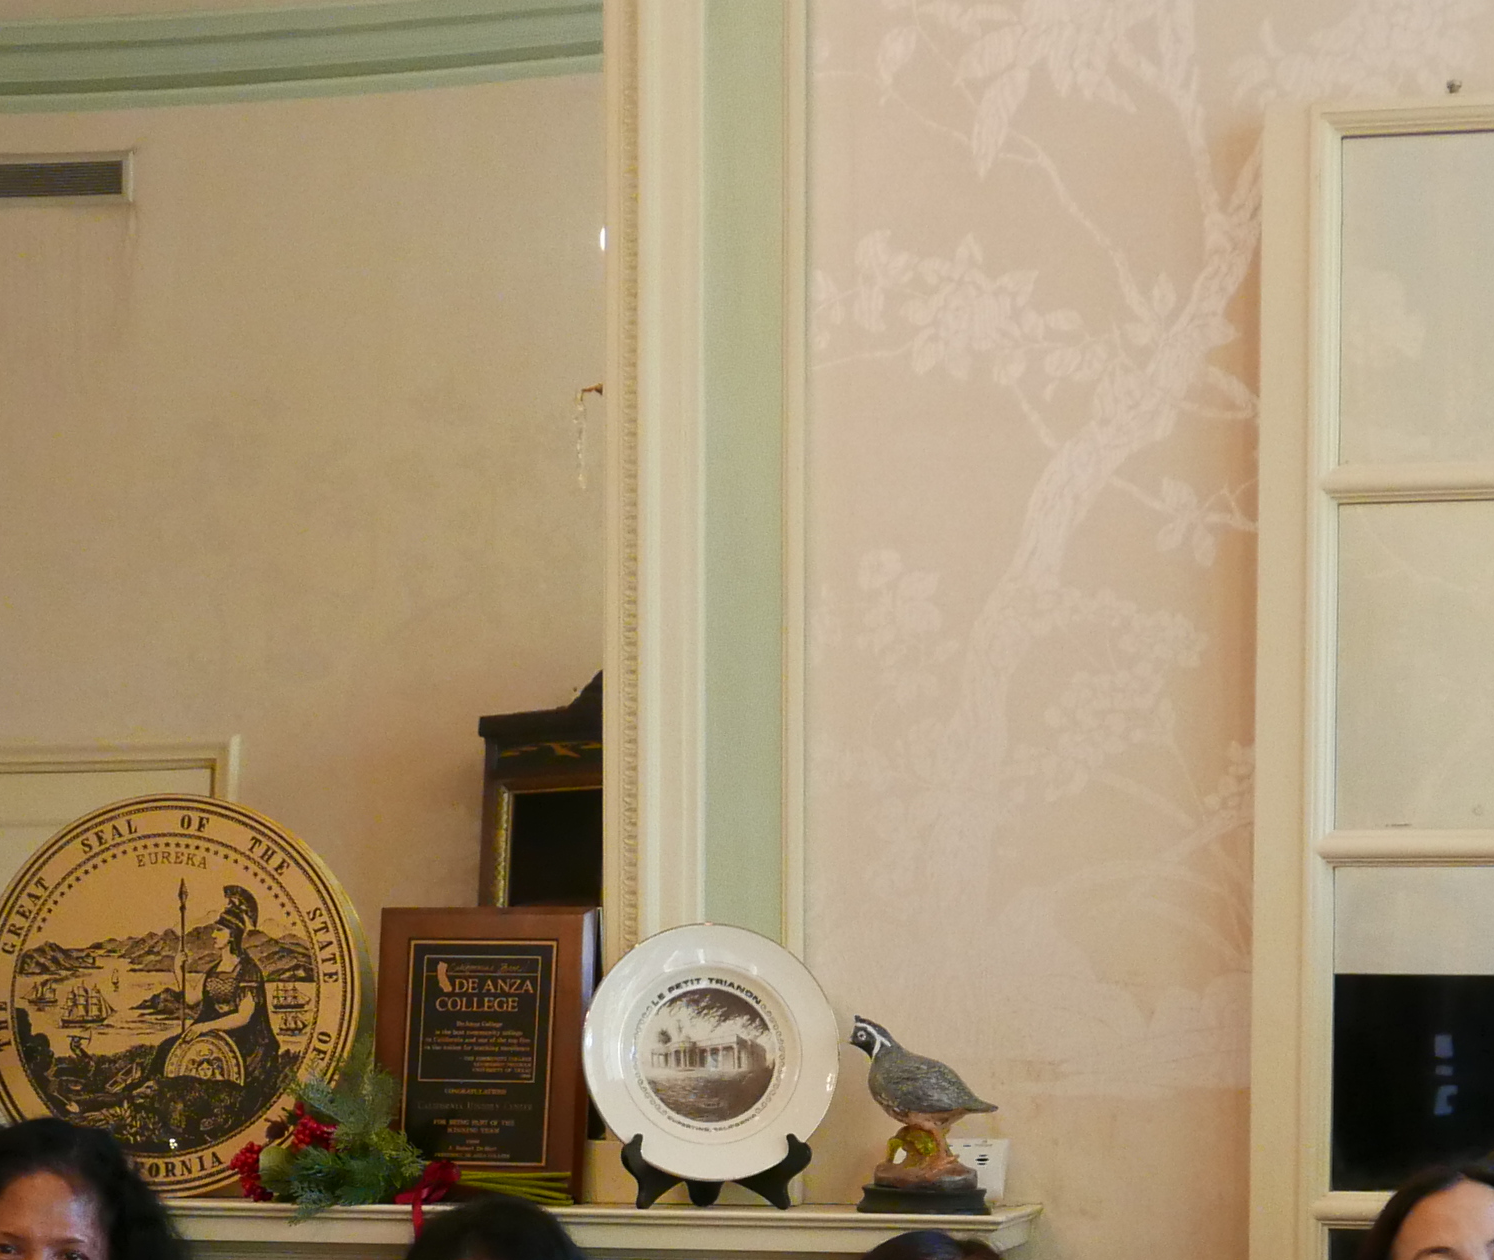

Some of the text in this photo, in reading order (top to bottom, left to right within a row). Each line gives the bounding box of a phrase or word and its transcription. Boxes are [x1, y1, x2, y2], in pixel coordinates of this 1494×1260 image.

[80, 818, 139, 855] SEAL
[180, 813, 211, 832] OF
[135, 851, 208, 870] EUREKA
[248, 835, 293, 877] THE
[2, 876, 52, 957] GREAT
[306, 906, 339, 985] STATE
[454, 978, 534, 994] DE ANZA
[651, 977, 762, 1007] LE PETIT TRIANON
[435, 996, 519, 1012] COLLEGE
[310, 1030, 333, 1062] OF
[134, 1151, 225, 1179] FORNIA
